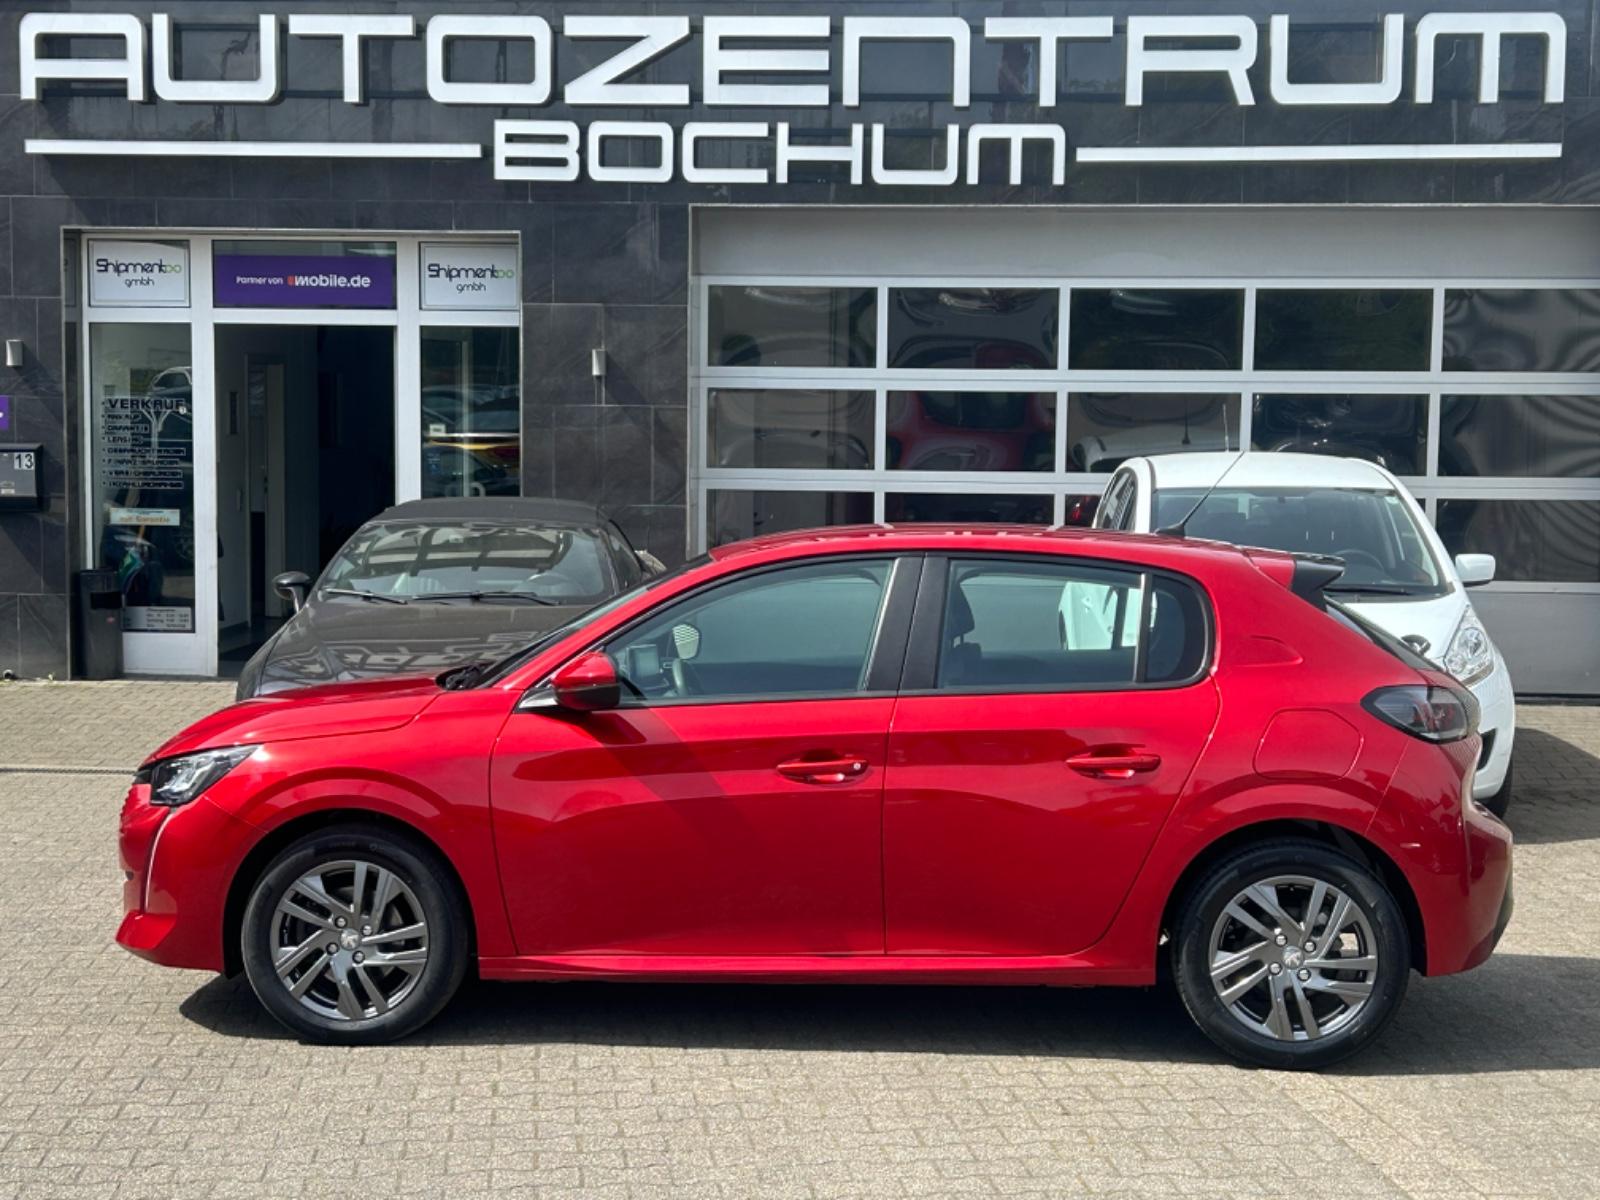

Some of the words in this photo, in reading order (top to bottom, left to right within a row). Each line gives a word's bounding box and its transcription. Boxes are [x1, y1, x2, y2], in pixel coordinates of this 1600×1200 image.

[20, 12, 1567, 107] AUTOZENTRUM
[492, 119, 1066, 186] BOCHUM
[125, 276, 154, 288] gmbh
[236, 275, 267, 285] Partner
[268, 276, 284, 285] von
[288, 273, 372, 288] mobile.de
[456, 281, 487, 293] gmbh
[108, 399, 185, 410] VERKAUF
[15, 453, 34, 470] 13
